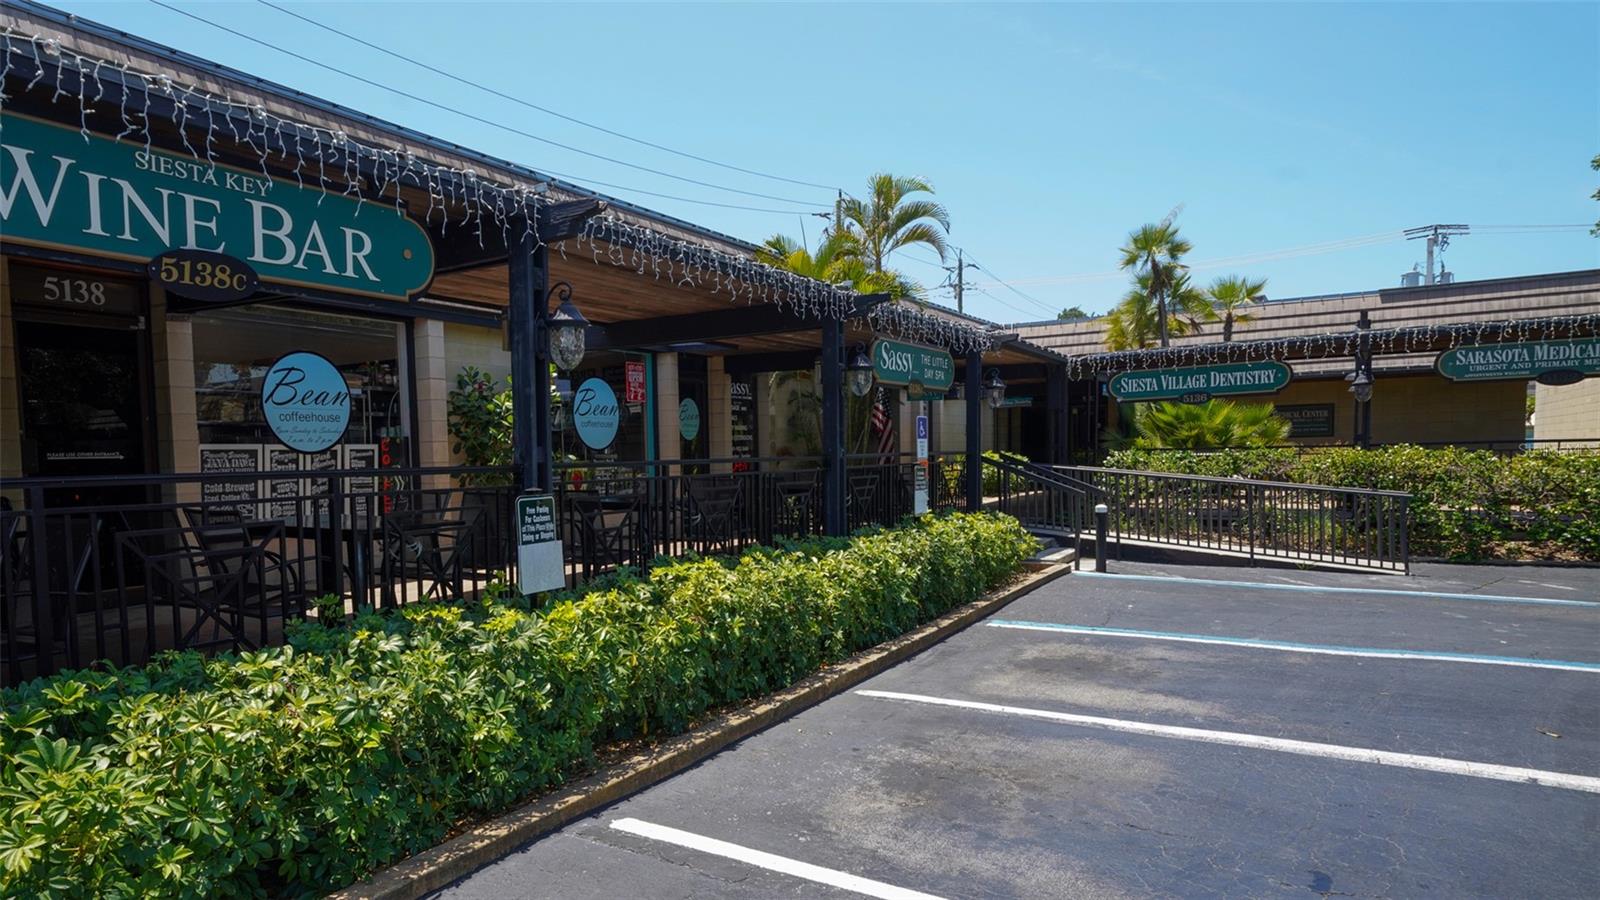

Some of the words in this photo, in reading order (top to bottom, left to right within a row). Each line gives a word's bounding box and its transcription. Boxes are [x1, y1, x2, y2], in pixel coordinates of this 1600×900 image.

[134, 151, 219, 186] SIESTA
[225, 171, 272, 197] KEY
[0, 143, 227, 254] WINE
[244, 198, 382, 282] BAR
[43, 276, 106, 306] 5138
[880, 341, 913, 380] Sassy
[1456, 347, 1531, 366] SARASOTA
[1469, 363, 1509, 372] URGENT
[1511, 361, 1532, 370] AND
[1535, 359, 1581, 368] PRIMARY
[265, 366, 350, 406] Bean
[1120, 376, 1158, 393] SIESTA
[1160, 373, 1207, 391] VILLAGE
[1210, 368, 1277, 388] DENTISTRY
[279, 411, 341, 423] coffeehouse
[575, 388, 619, 417] Bean
